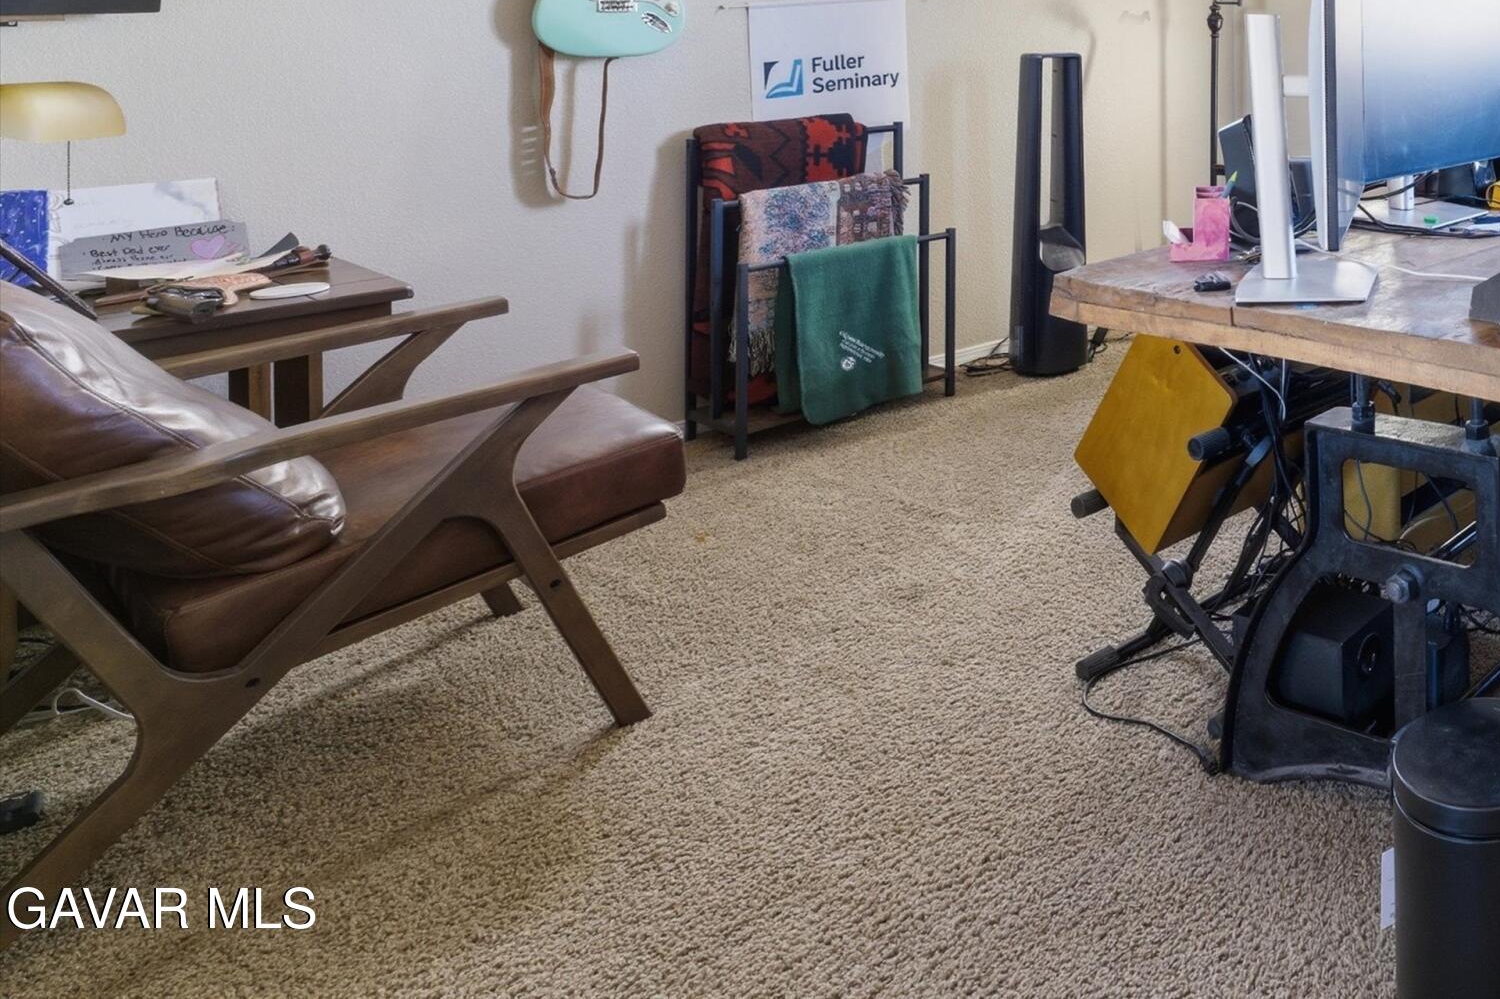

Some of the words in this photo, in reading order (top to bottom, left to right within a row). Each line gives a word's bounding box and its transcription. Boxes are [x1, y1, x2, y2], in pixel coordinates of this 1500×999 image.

[811, 54, 865, 73] Fuller
[812, 72, 899, 94] Seminary
[139, 229, 168, 239] Hero
